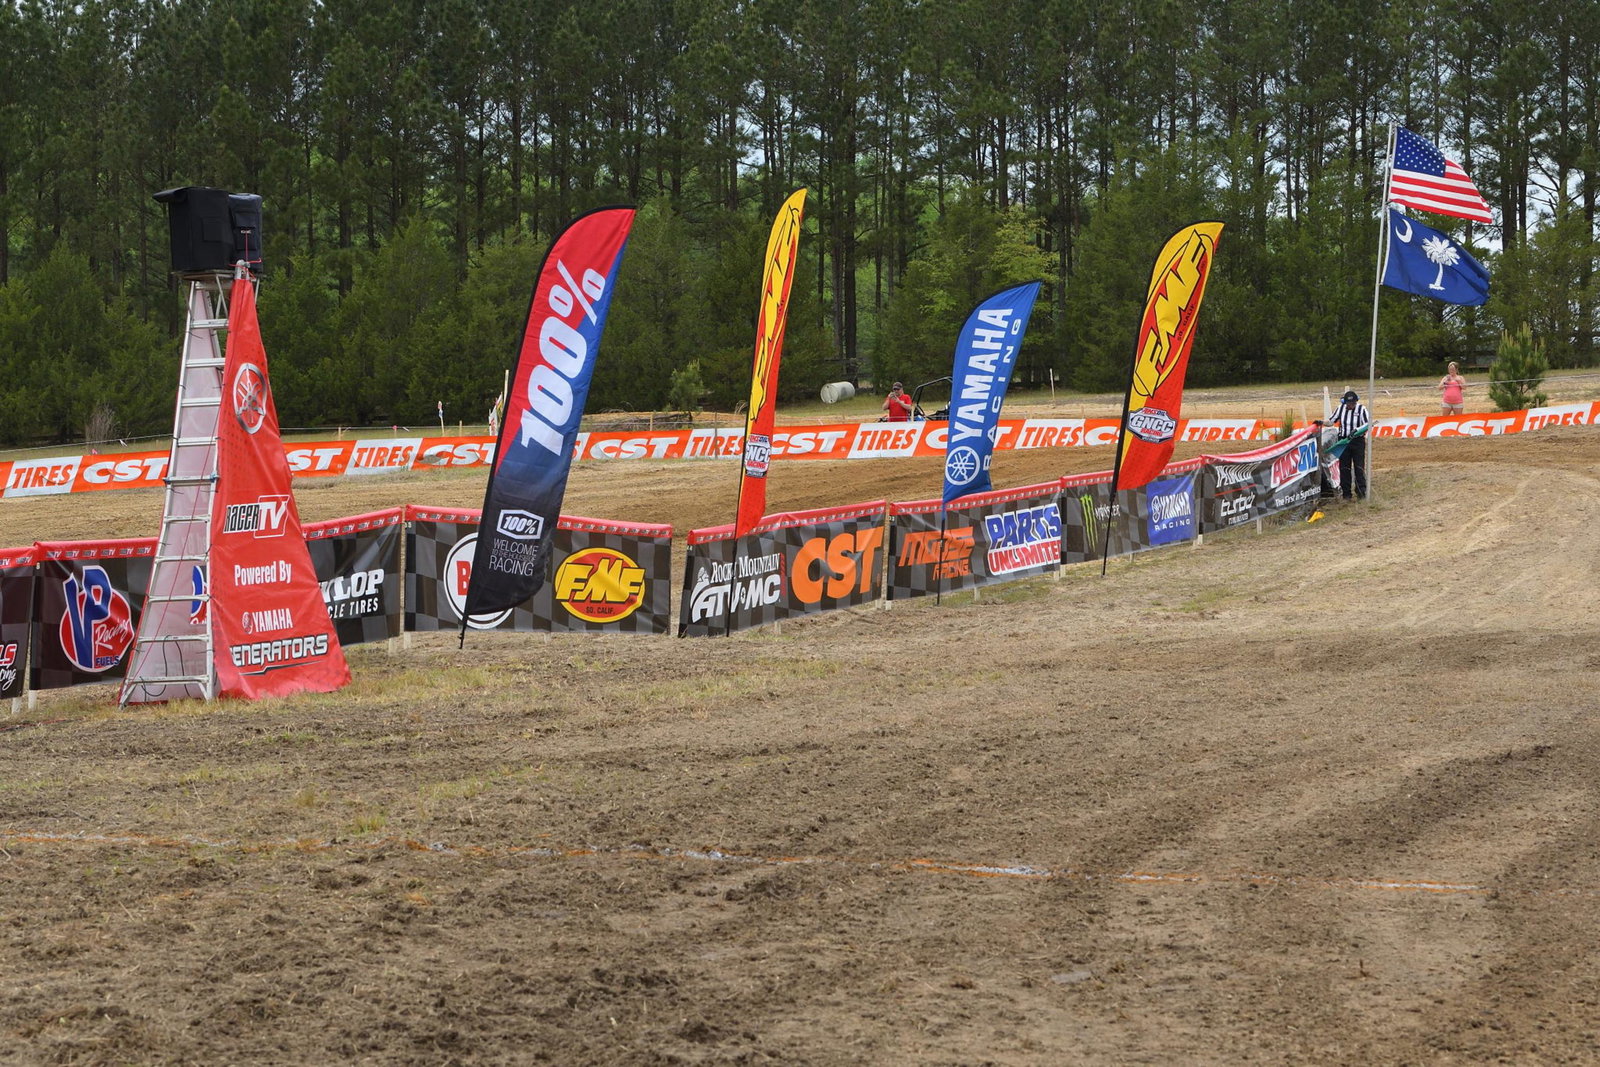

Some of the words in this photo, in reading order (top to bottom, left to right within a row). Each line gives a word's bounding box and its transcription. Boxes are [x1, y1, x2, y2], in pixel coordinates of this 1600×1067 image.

[1135, 229, 1206, 399] FMF
[521, 259, 606, 456] 100%
[951, 308, 1014, 443] YAMAHA
[983, 318, 1022, 472] RACING
[1023, 426, 1083, 447] TIRES
[1131, 415, 1173, 433] GNCC
[590, 437, 680, 460] CST
[857, 429, 916, 450] TIRES
[287, 447, 343, 471] ST
[353, 446, 414, 468] TIRES
[1271, 438, 1319, 488] AMSOIL
[14, 464, 74, 489] TIRES
[83, 457, 169, 483] CST
[1160, 491, 1191, 520] YAMAHA
[1275, 498, 1285, 507] The
[503, 516, 537, 534] 100%
[985, 503, 1061, 550] PARTS
[1154, 519, 1191, 531] RACING
[493, 538, 539, 556] WELCOME
[234, 563, 277, 586] Powered
[278, 560, 292, 583] By
[489, 554, 534, 576] RACING
[739, 552, 780, 577] MOUNTAIN
[792, 526, 884, 604] CST
[556, 558, 646, 604] FMF
[350, 597, 379, 616] TIRES
[252, 608, 293, 632] YAMAHA
[95, 617, 131, 656] Racing
[95, 655, 121, 667] FUELS
